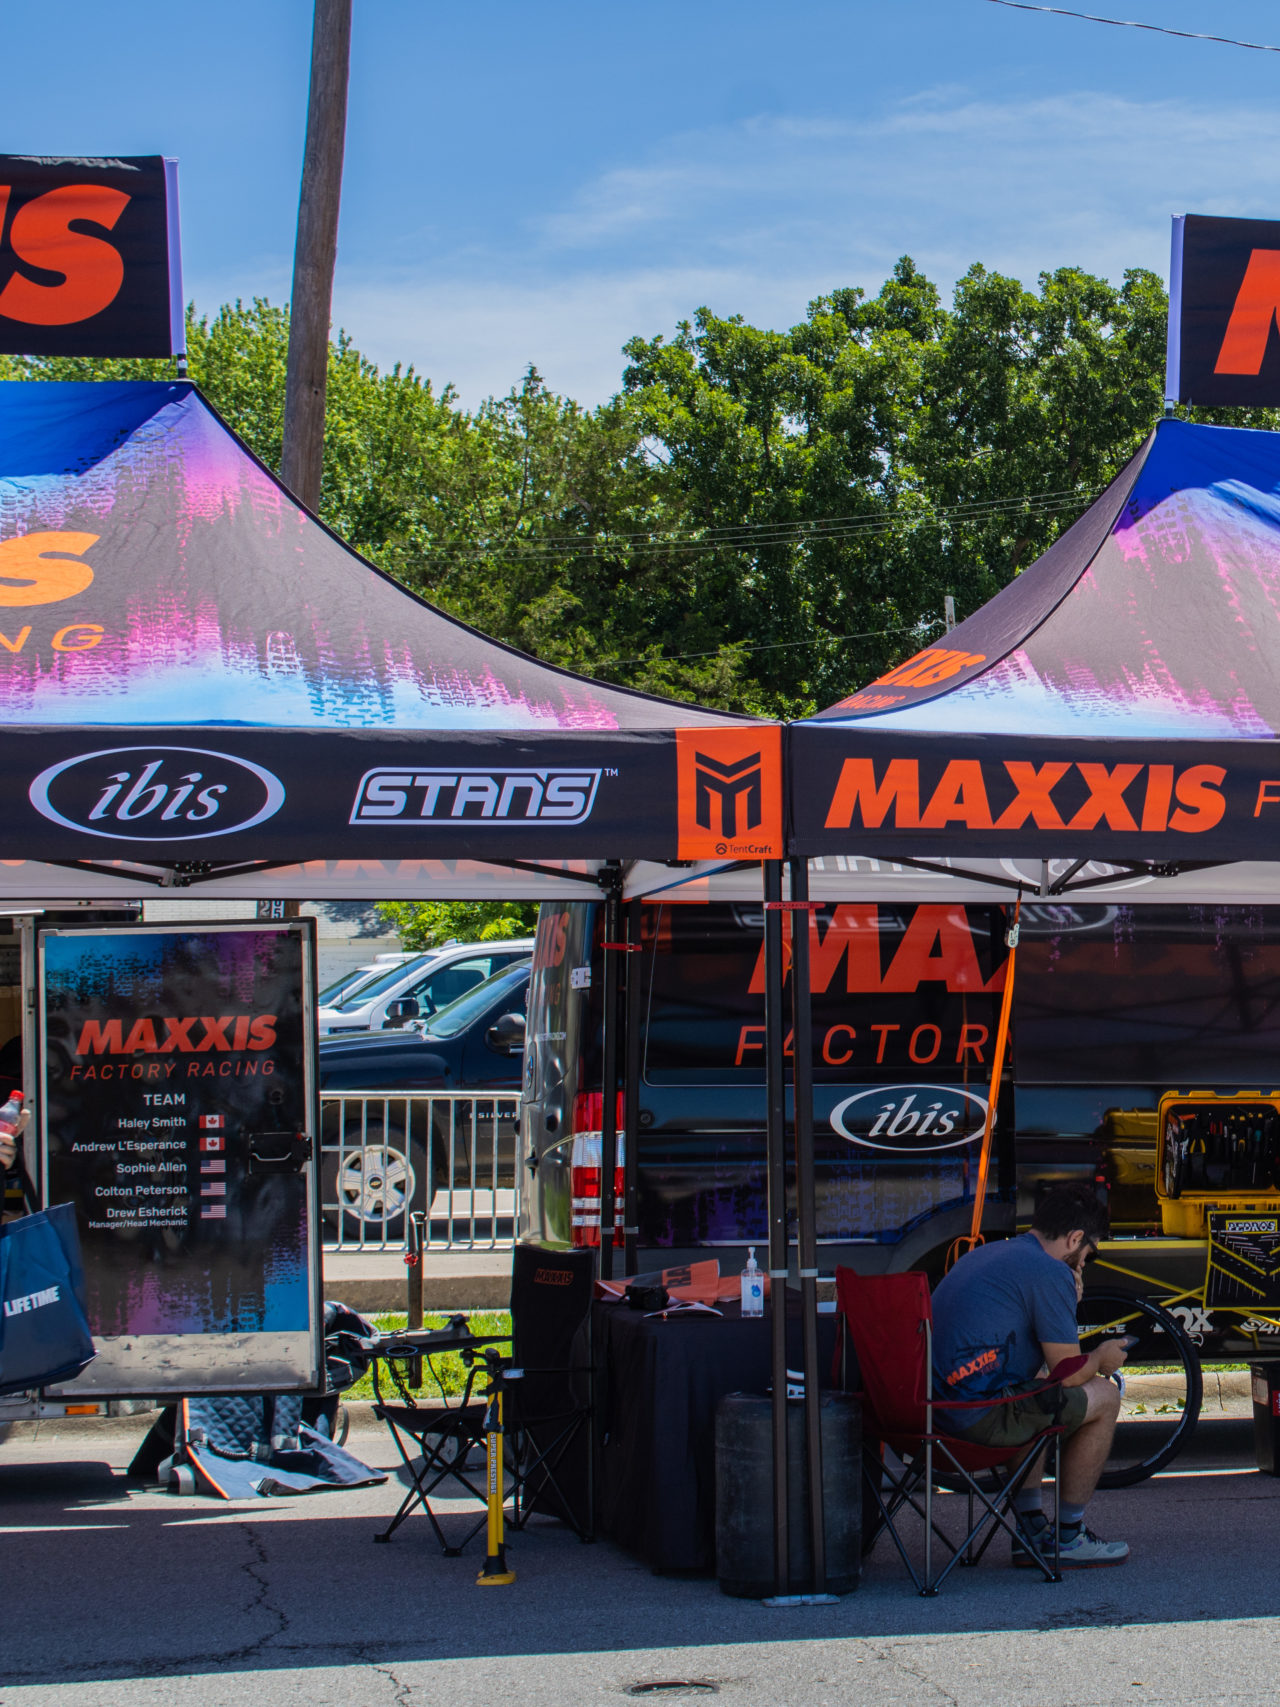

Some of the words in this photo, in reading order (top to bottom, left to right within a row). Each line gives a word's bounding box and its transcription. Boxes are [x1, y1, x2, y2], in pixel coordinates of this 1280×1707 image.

[0, 185, 131, 326] S
[88, 760, 228, 822] ibis
[825, 758, 1227, 832] MAXXIS
[729, 844, 773, 855] TentCraft
[747, 904, 1006, 993] MA
[75, 1014, 278, 1056] MAXXIS
[735, 1024, 1012, 1066] FCTOR
[70, 1063, 176, 1080] FACTORY
[187, 1060, 275, 1077] RACING
[144, 1093, 186, 1106] TEAM
[118, 1118, 150, 1130] Haley
[152, 1117, 187, 1128] Smith
[869, 1093, 960, 1136] ibis
[72, 1141, 116, 1152] Andrew
[118, 1140, 187, 1153] L'Esperance
[116, 1163, 156, 1175] Sophie
[158, 1162, 187, 1172] Allen
[95, 1186, 133, 1197] Colton
[135, 1185, 187, 1196] Peterson
[107, 1208, 136, 1218] Drew
[138, 1206, 188, 1217] Esherick
[149, 1218, 188, 1228] Mechanic
[946, 1349, 998, 1387] MAXXIS
[490, 1433, 498, 1457] SUPER
[490, 1459, 498, 1495] PRESTIGE
